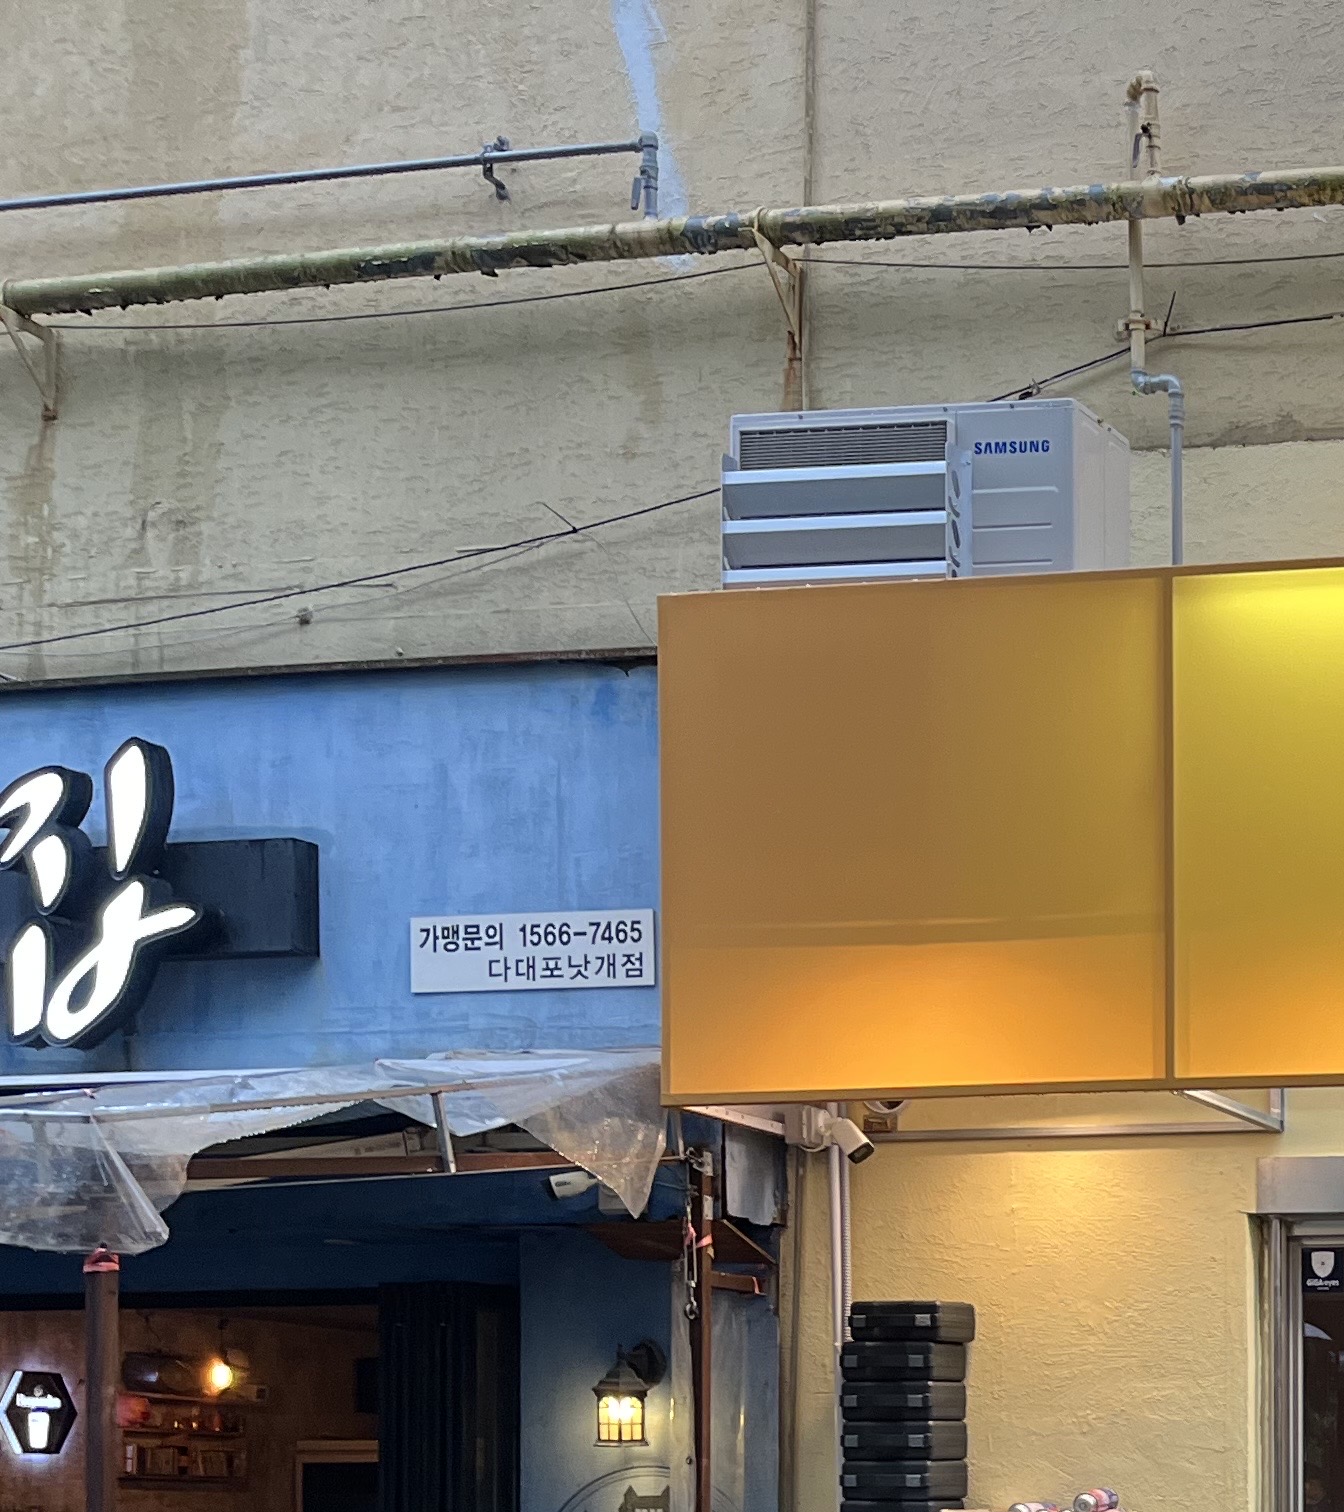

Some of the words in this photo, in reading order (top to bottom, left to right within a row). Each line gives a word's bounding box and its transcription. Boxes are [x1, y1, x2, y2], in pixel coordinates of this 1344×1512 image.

[974, 439, 1050, 455] SAMSUNG
[419, 922, 504, 953] 가맹문의
[518, 919, 643, 948] 1566-7465
[488, 951, 644, 982] 다대포낫개점
